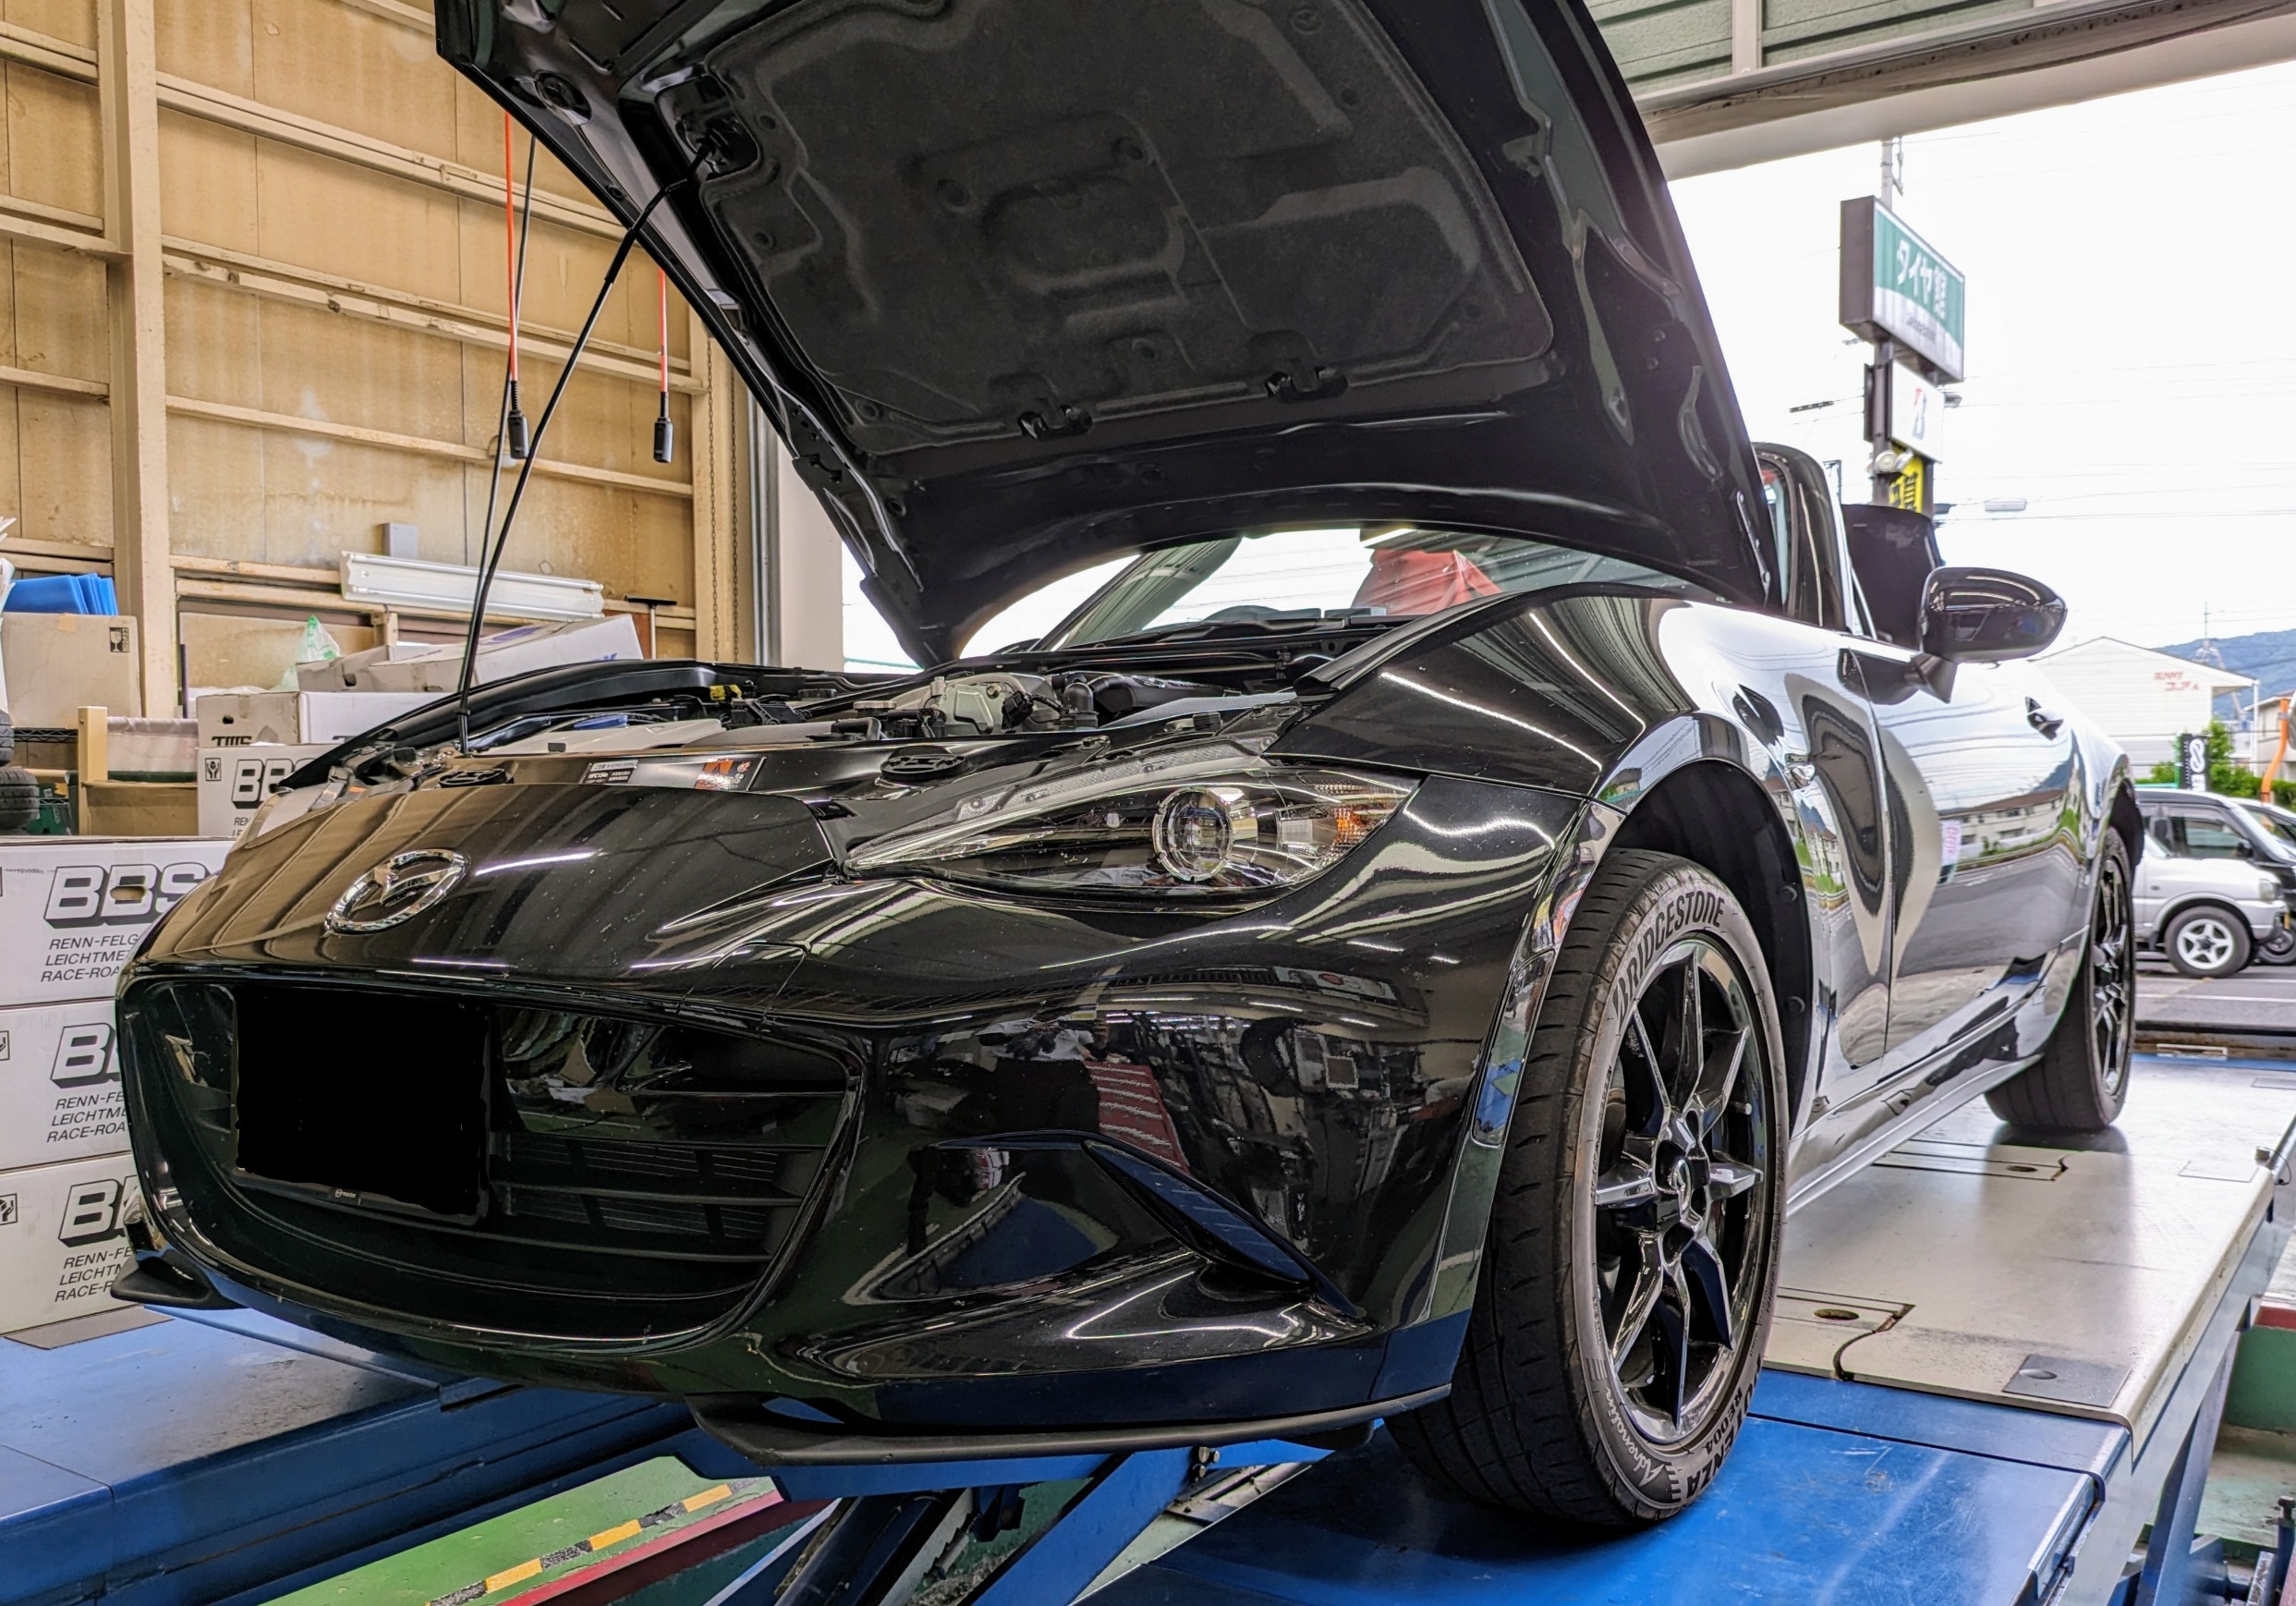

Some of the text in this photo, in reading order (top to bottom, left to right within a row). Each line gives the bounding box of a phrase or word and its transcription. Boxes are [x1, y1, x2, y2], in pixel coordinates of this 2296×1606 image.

[231, 758, 316, 809] BB
[45, 949, 131, 967] LEICHTME
[1611, 890, 1725, 1032] BRIDGESTONE
